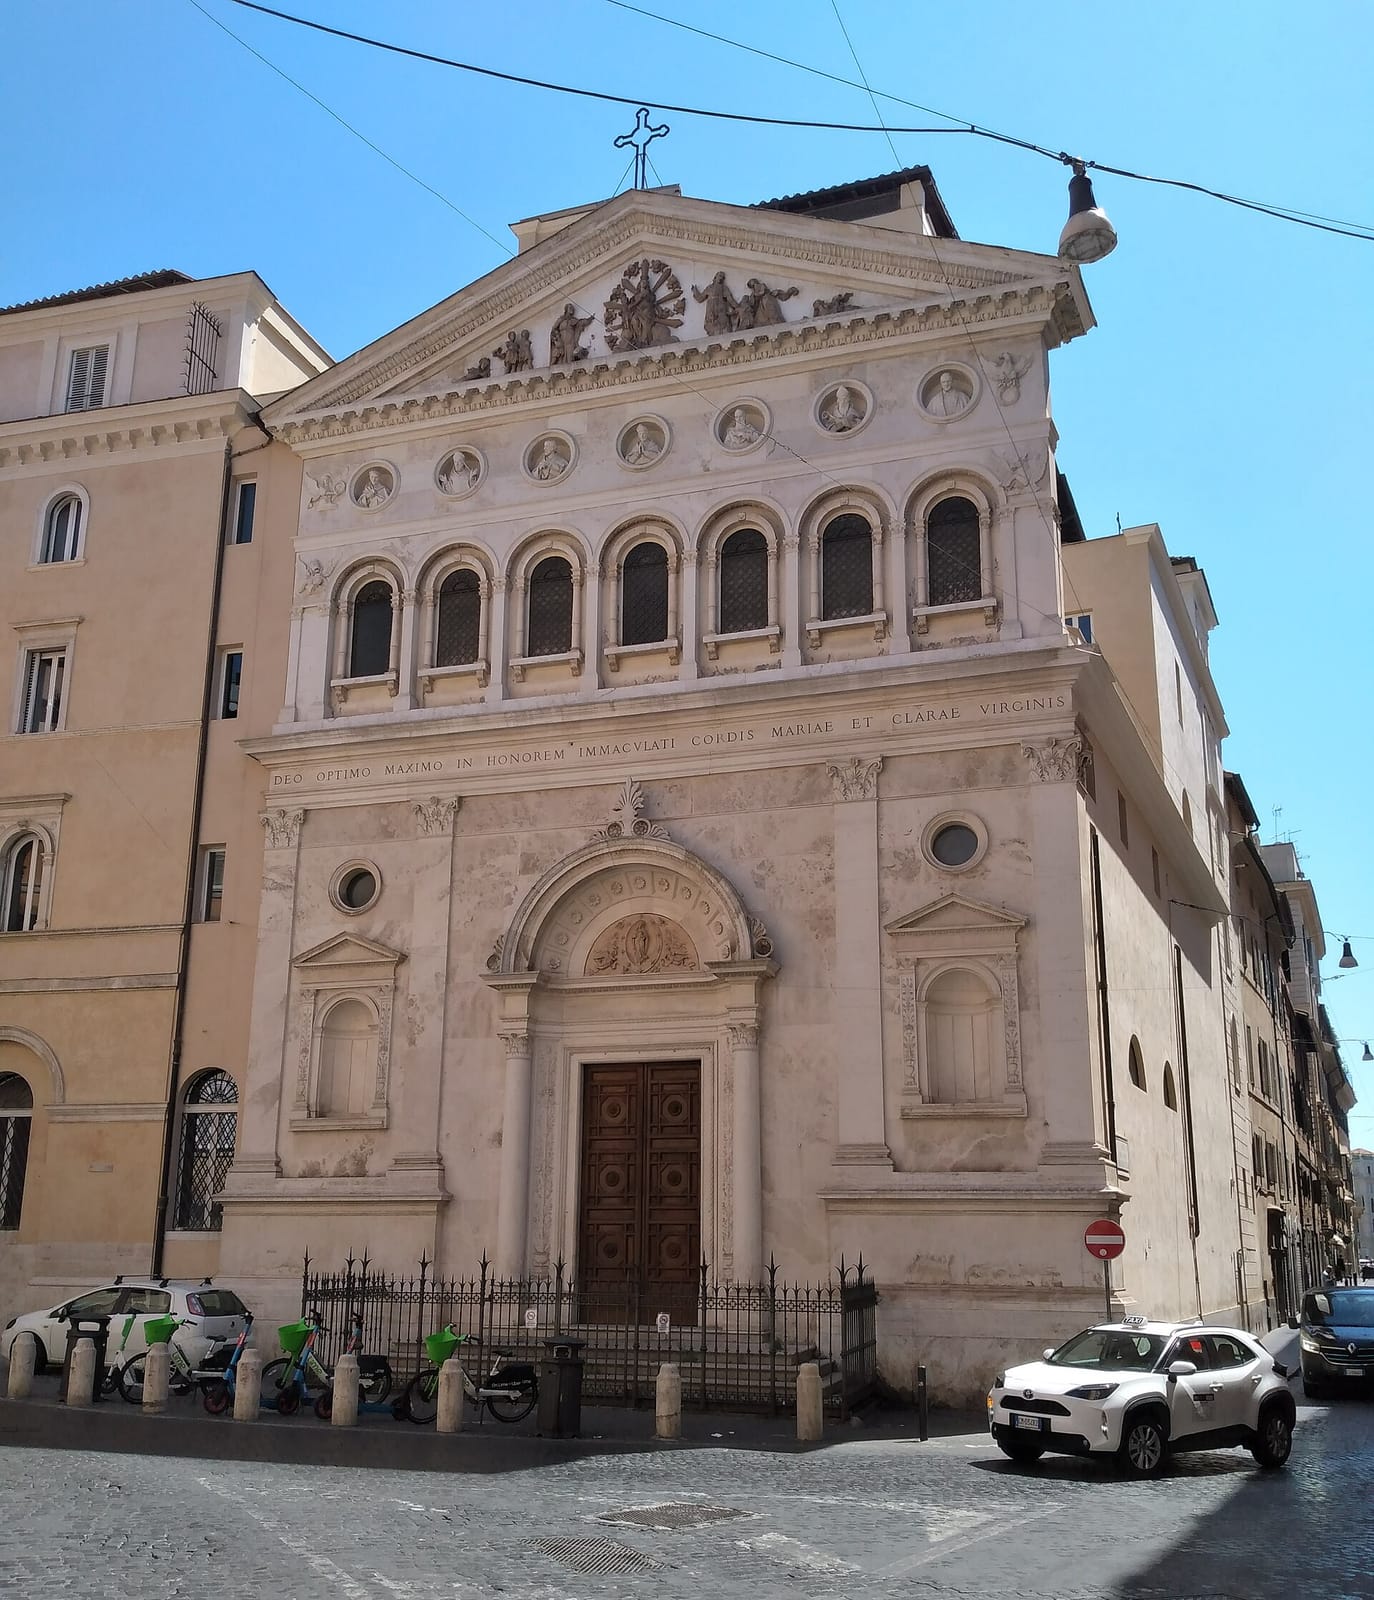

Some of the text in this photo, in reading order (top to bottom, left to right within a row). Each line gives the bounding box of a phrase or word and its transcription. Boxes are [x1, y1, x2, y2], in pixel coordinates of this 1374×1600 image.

[273, 695, 1065, 786] DEO OPTIMO MAXIMO IN HONOREM IMMACVLATI CORDIS MARIAE ET CLARAE VIRGINIS
[1123, 1316, 1144, 1325] TAXI
